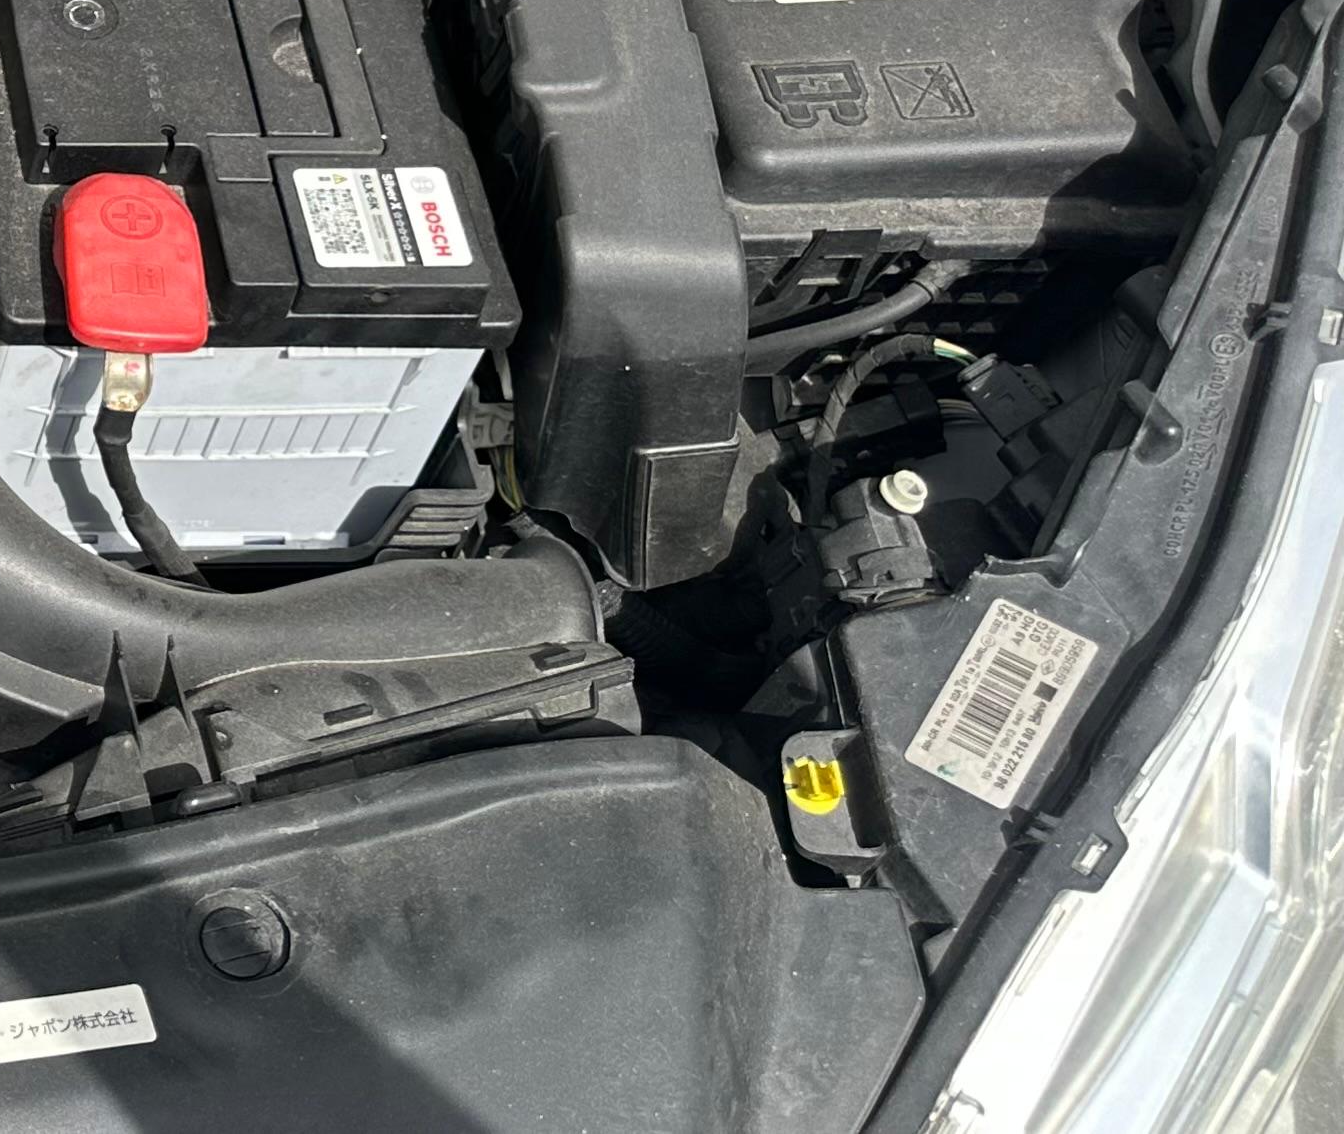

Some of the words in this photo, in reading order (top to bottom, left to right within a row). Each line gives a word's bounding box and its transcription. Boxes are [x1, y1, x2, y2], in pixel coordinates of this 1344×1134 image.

[380, 173, 400, 201] Silver
[420, 201, 453, 256] BOSCH
[1011, 631, 1025, 645] A9
[1019, 615, 1034, 631] HG
[1029, 620, 1048, 643] GTG
[1001, 757, 1018, 776] 022
[1021, 726, 1035, 740] 80
